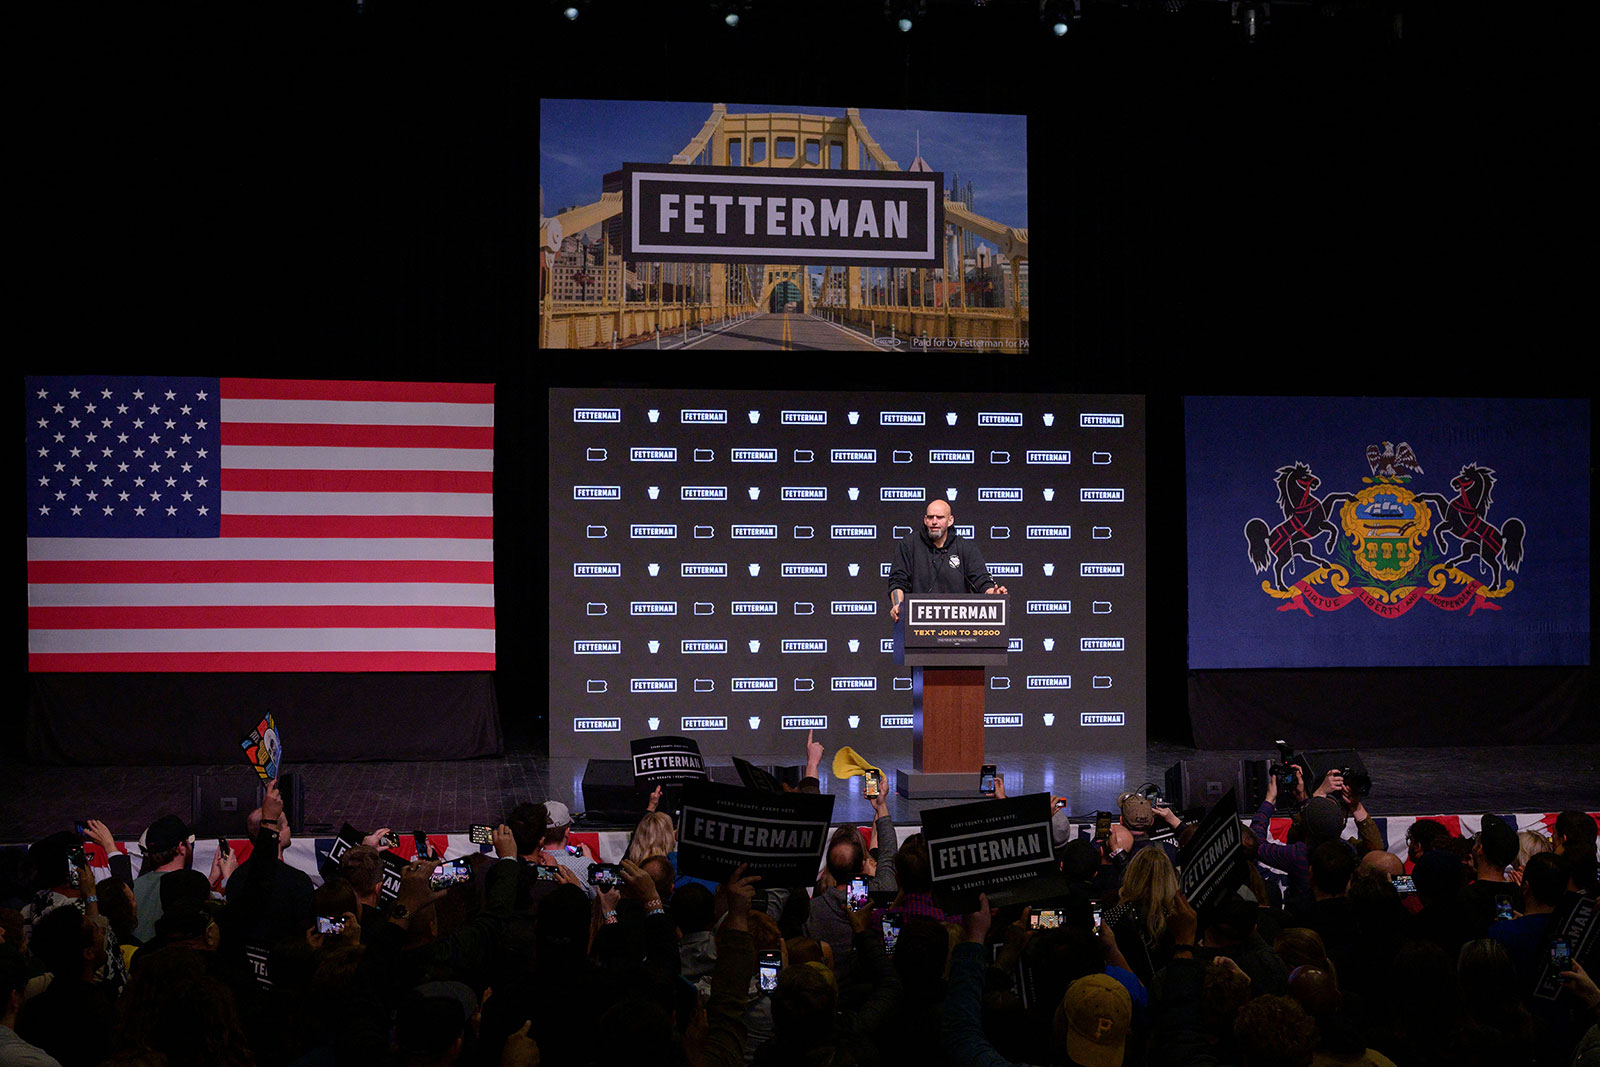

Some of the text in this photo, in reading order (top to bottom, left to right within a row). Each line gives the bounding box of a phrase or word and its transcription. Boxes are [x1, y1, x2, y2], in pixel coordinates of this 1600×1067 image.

[660, 194, 908, 239] FETTERMAN
[913, 338, 1029, 349] Paid for by Fetterman for PA
[578, 411, 617, 419] FETTERMAN
[685, 413, 724, 421] FETTERMAN
[785, 414, 824, 422] FETTERMAN
[884, 415, 922, 423] FETTERMAN
[982, 416, 1019, 424] FETTERMAN
[1084, 417, 1121, 425] FETTERMAN
[634, 451, 674, 459] FETTERMAN
[735, 451, 774, 459] FETTERMAN
[835, 452, 873, 460] FETTERMAN
[933, 453, 971, 461] FETTERMAN
[1031, 454, 1068, 462] FETTERMAN
[578, 489, 617, 497] FETTERMAN
[685, 489, 724, 497] FETTERMAN
[785, 490, 824, 498] FETTERMAN
[884, 491, 922, 499] FETTERMAN
[982, 491, 1020, 499] FETTERMAN
[1084, 491, 1121, 499] FETTERMAN
[635, 528, 674, 536] FETTERMAN
[735, 528, 774, 536] FETTERMAN
[835, 528, 873, 536] FETTERMAN
[1031, 529, 1068, 537] FETTERMAN
[578, 566, 617, 574] FETTERMAN
[685, 566, 724, 574] FETTERMAN
[785, 566, 824, 574] FETTERMAN
[986, 566, 1020, 574] ETTERMAN
[1084, 566, 1121, 574] FETTERMAN
[1303, 586, 1340, 608] VIRTUE
[1429, 582, 1478, 609] INDEPENDENCE
[1358, 591, 1419, 615] LIBERTY AND
[635, 605, 674, 613] FETTERMAN
[736, 604, 774, 612] FETTERMAN
[835, 604, 873, 612] FETTERMAN
[917, 605, 997, 619] FETTERMAN
[1031, 604, 1068, 612] FETTERMAN
[578, 643, 617, 651] FETTERMAN
[685, 643, 724, 651] FETTERMAN
[785, 642, 824, 650] FETTERMAN
[1084, 641, 1121, 649] FETTERMAN
[635, 681, 674, 689] FETTERMAN
[736, 681, 774, 689] FETTERMAN
[835, 680, 873, 688] FETTERMAN
[1031, 678, 1068, 686] FETTERMAN
[685, 719, 724, 727] FETTERMAN
[785, 718, 824, 726] FETTERMAN
[884, 717, 914, 725] FETTERM
[1084, 715, 1121, 723] FETTERMAN
[578, 720, 617, 728] FETTERMAN
[640, 755, 701, 770] FETTERMAN
[693, 816, 814, 849] FETTERMAN
[938, 832, 1041, 870] FETTERMAN
[1184, 825, 1235, 894] FETTERMAN
[963, 880, 985, 889] SENATE
[992, 871, 1038, 884] PENNSYLVANIA
[1096, 1018, 1113, 1040] P
